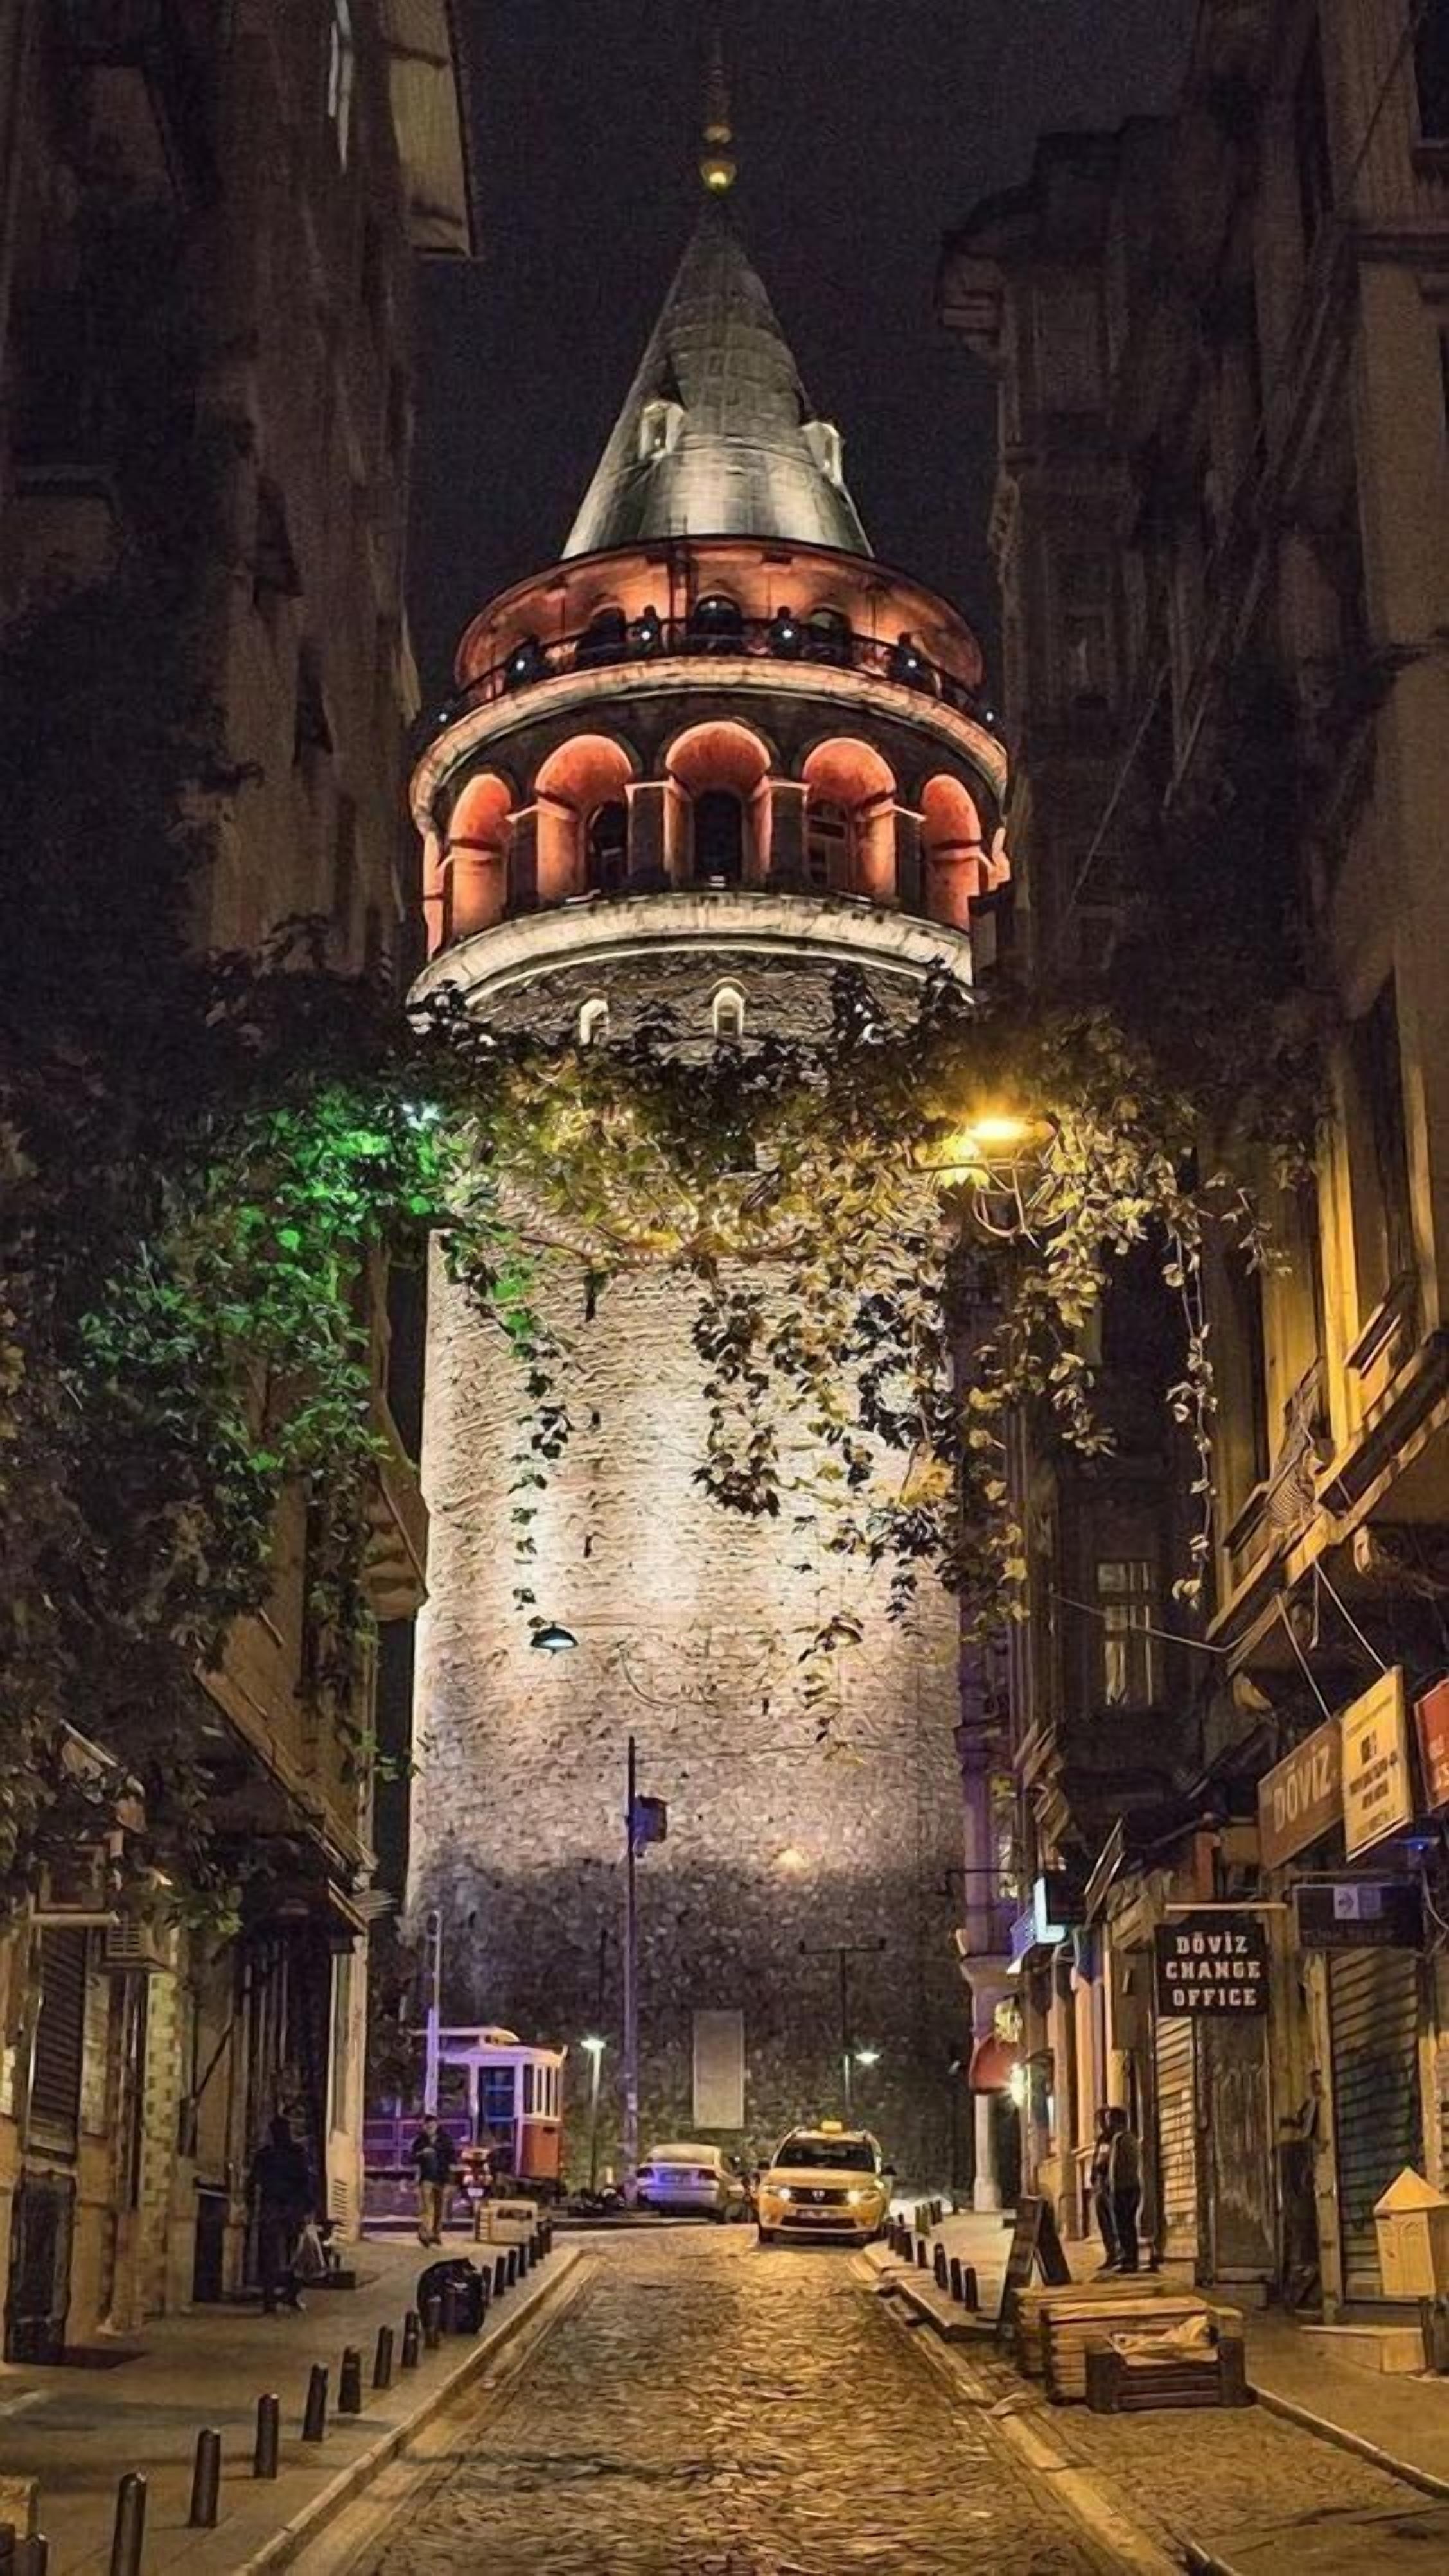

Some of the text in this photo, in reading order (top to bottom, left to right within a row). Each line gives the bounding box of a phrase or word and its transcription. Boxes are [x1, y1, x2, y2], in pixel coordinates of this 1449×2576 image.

[1176, 1931, 1249, 1954] DÖVİZ
[1166, 1961, 1261, 1979] CHANGE
[1173, 1988, 1257, 2006] OFFICE
